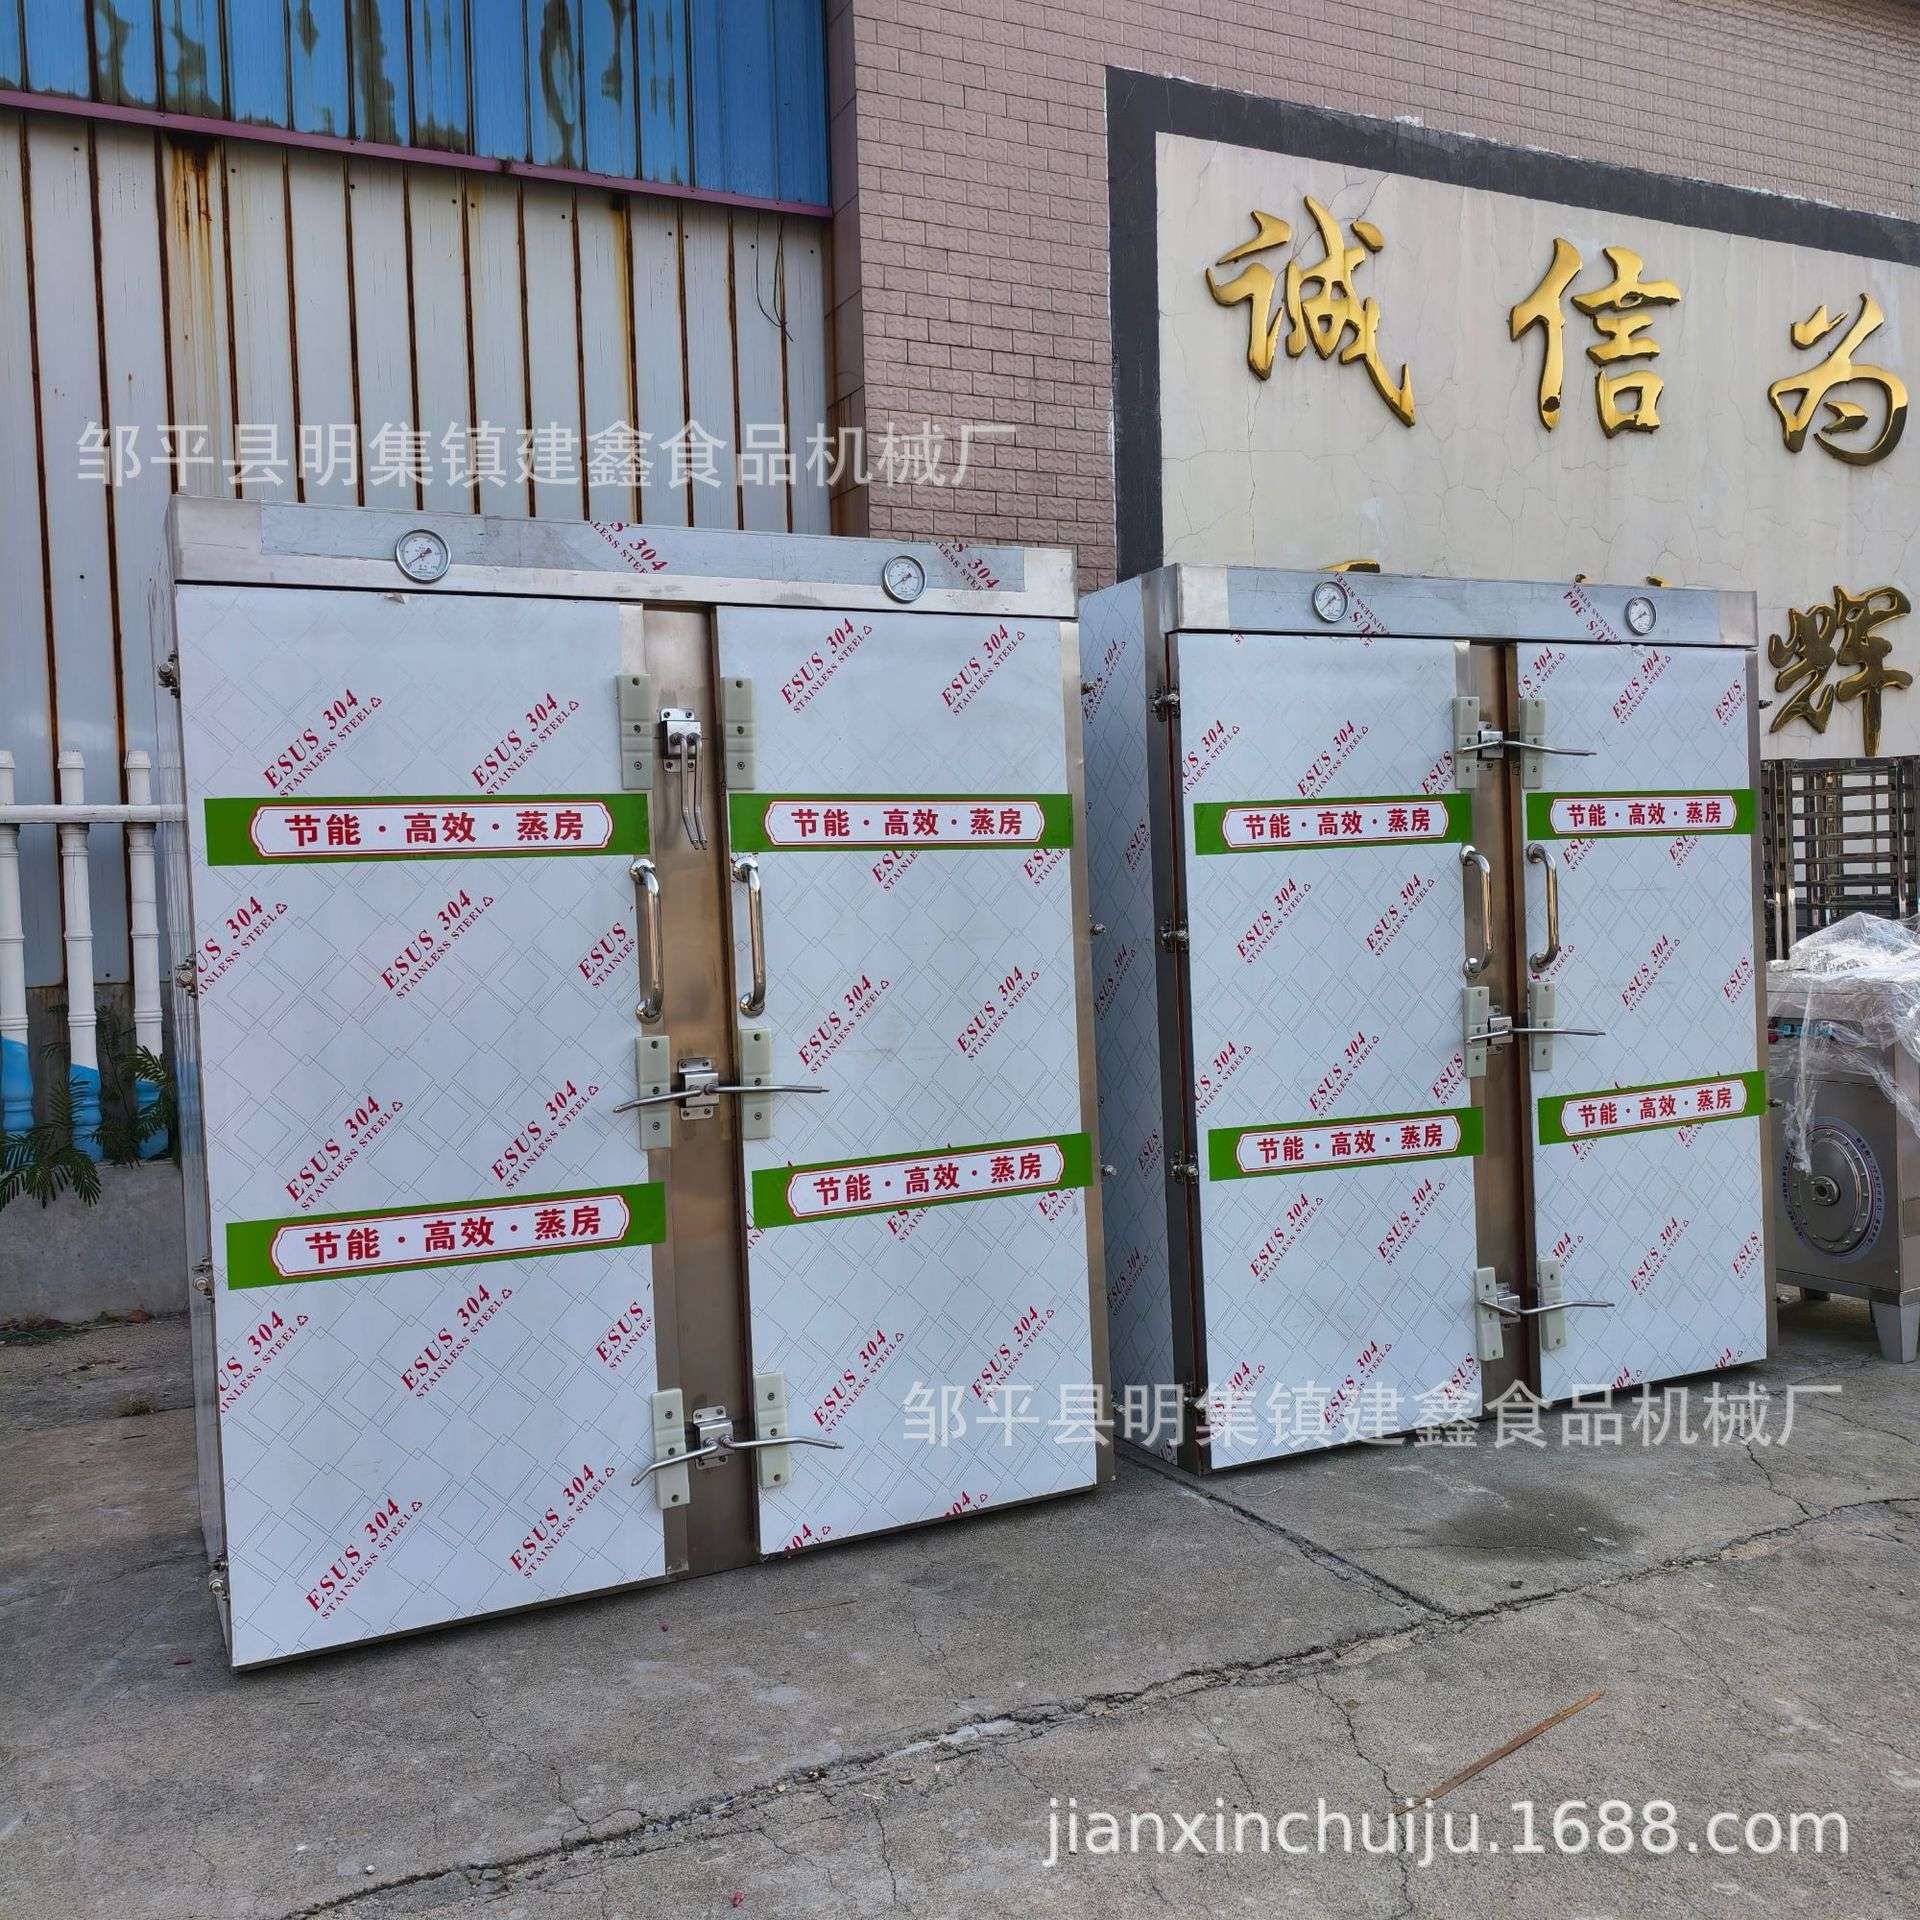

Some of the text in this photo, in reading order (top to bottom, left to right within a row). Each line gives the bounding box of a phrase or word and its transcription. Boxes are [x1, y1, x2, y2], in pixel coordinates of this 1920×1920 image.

[629, 539, 668, 571] 304
[968, 558, 1000, 589] 304
[780, 617, 855, 706] ESUS 304
[940, 624, 1009, 708] ESUS 304
[262, 689, 359, 790] ESUS 304
[280, 707, 373, 797] STAINLESS STEEL
[471, 693, 560, 788] ESUS 304
[486, 709, 571, 796] STAINLESS STEEL
[1202, 720, 1225, 752] 304
[1297, 721, 1355, 797] ESUS 304
[1420, 751, 1452, 795] ESUS
[226, 896, 263, 939] 304
[241, 913, 277, 949] STEEL
[380, 889, 472, 990] ESUS 304
[396, 907, 484, 1000] STAINLESS STEEL
[576, 921, 627, 981] ESUS
[1236, 878, 1297, 958] ESUS 304
[1365, 874, 1422, 952] ESUS 304
[799, 975, 872, 1067] ESUS 304
[956, 966, 1023, 1054] ESUS 304
[1214, 1041, 1236, 1075] 304
[1307, 1031, 1366, 1112] ESUS 304
[1431, 1053, 1464, 1100] ESUS
[285, 1096, 380, 1201] ESUS 304
[301, 1111, 393, 1210] STAINLESS STEEL
[491, 1079, 578, 1182] ESUS 304
[506, 1095, 590, 1190] STAINLESS STEEL
[1250, 1194, 1309, 1278] ESUS 304
[1377, 1178, 1433, 1259] ESUS 304
[248, 1310, 284, 1356] 304
[262, 1326, 298, 1364] STEEL
[401, 1284, 490, 1391] ESUS 304
[416, 1299, 503, 1399] STAINLESS STEEL
[595, 1301, 644, 1364] ESUS
[971, 1306, 1038, 1400] ESUS 304
[1356, 1341, 1378, 1374] 304
[812, 1330, 887, 1428] ESUS 304
[305, 1498, 401, 1611] ESUS 304
[509, 1464, 595, 1572] ESUS 304
[524, 1477, 606, 1579] STAINLESS STEEL
[322, 1514, 413, 1620] STAINLESS STEEL
